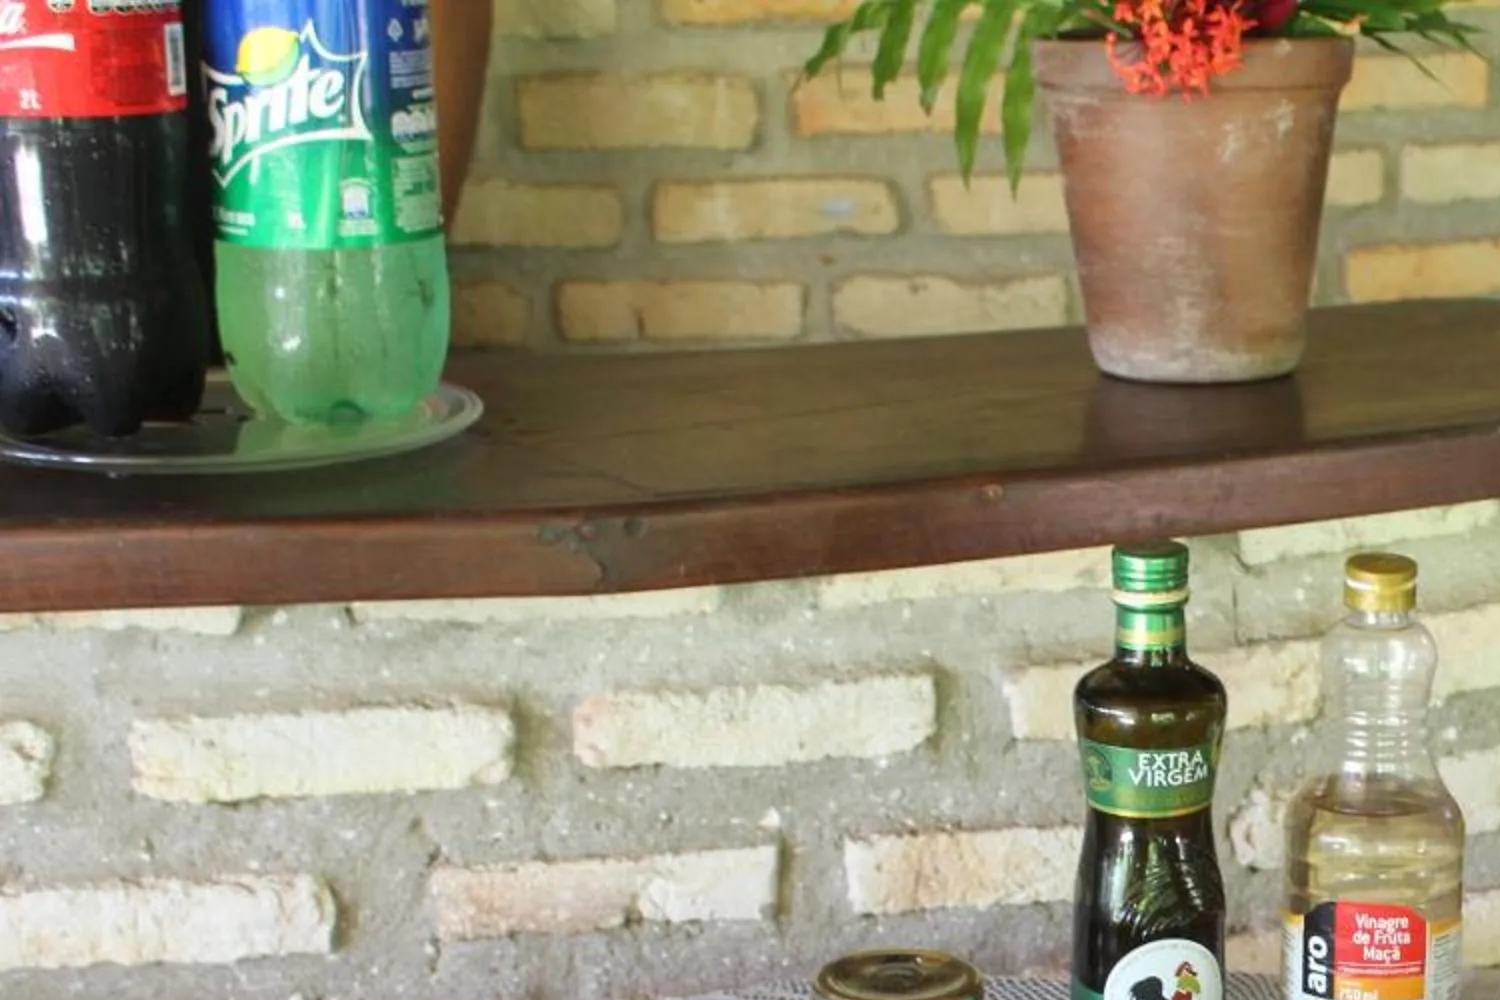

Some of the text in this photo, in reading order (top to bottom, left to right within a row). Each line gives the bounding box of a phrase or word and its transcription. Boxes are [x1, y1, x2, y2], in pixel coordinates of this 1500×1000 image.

[209, 53, 344, 166] Sprite
[1137, 750, 1203, 770] EXTRA
[1128, 764, 1208, 787] VIRGEM
[1355, 912, 1409, 934] Vinagre
[1353, 929, 1411, 945] de Fruta
[1308, 935, 1328, 995] aro
[1363, 946, 1401, 966] Maçã
